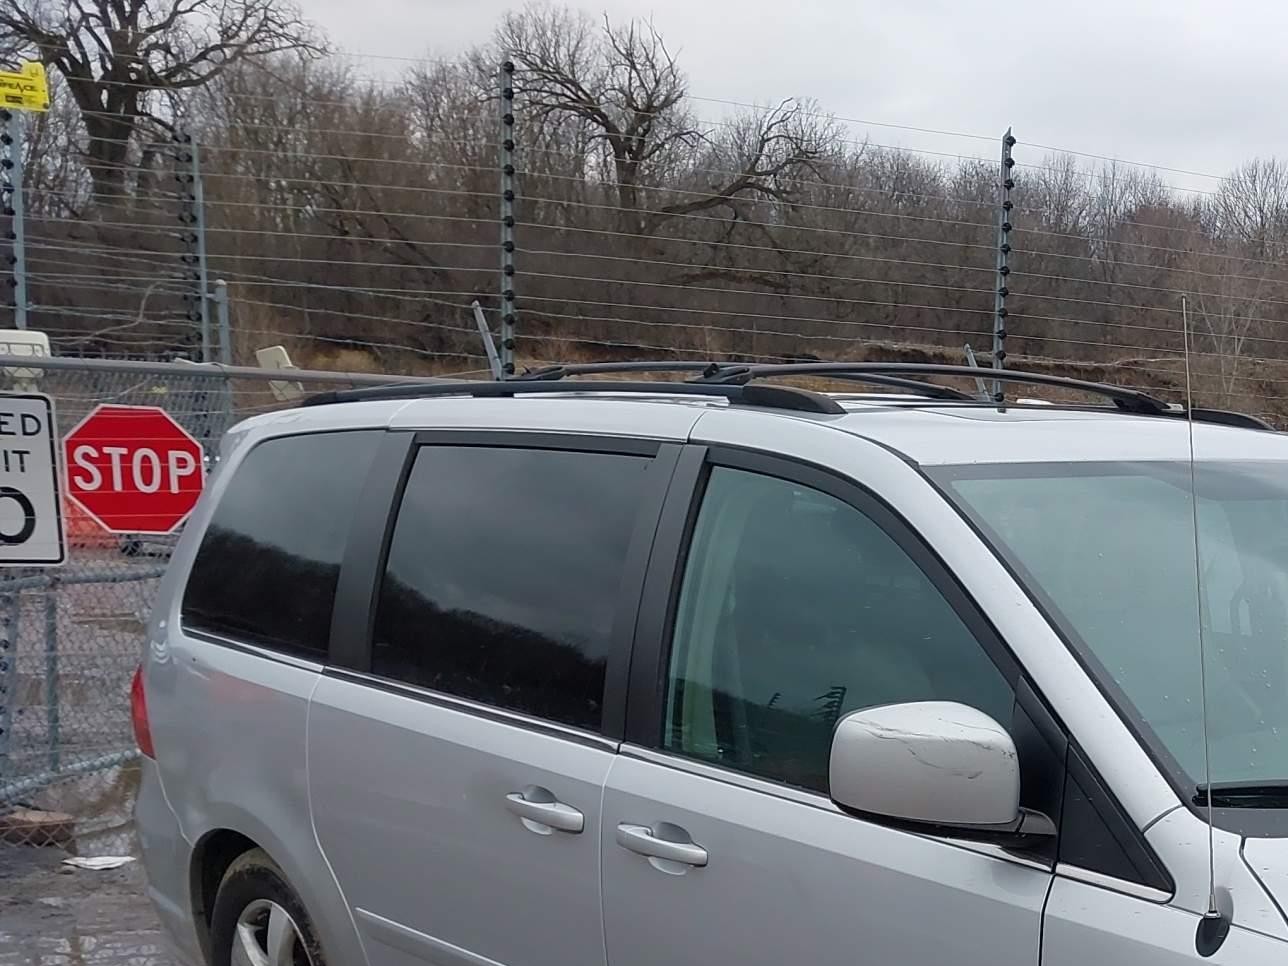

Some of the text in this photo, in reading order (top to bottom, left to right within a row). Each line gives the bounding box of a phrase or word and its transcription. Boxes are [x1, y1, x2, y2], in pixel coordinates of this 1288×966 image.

[0, 411, 41, 436] ED
[3, 449, 31, 473] IT
[73, 445, 196, 494] STOP
